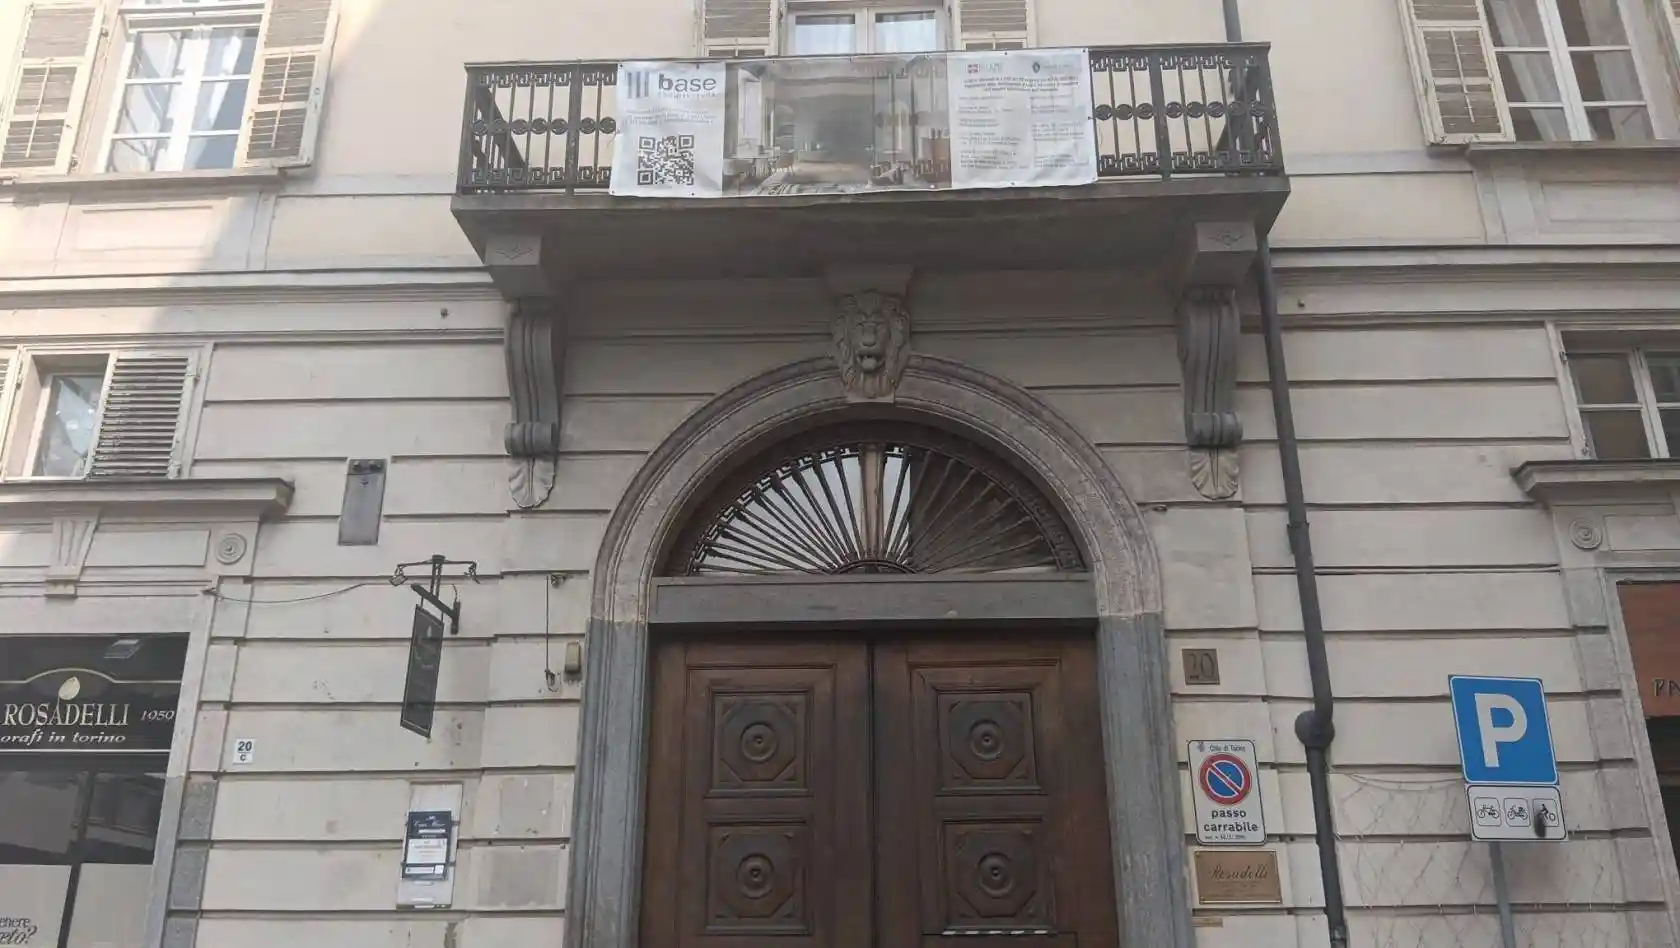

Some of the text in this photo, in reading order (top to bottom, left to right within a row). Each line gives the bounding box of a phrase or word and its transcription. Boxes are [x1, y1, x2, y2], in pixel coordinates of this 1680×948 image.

[659, 73, 717, 92] base
[2, 702, 131, 727] ROSADELLI
[0, 727, 127, 746] orafi in torino
[1474, 692, 1528, 768] P
[237, 740, 253, 752] 20
[1211, 809, 1247, 819] passo
[1203, 821, 1259, 832] carrabile
